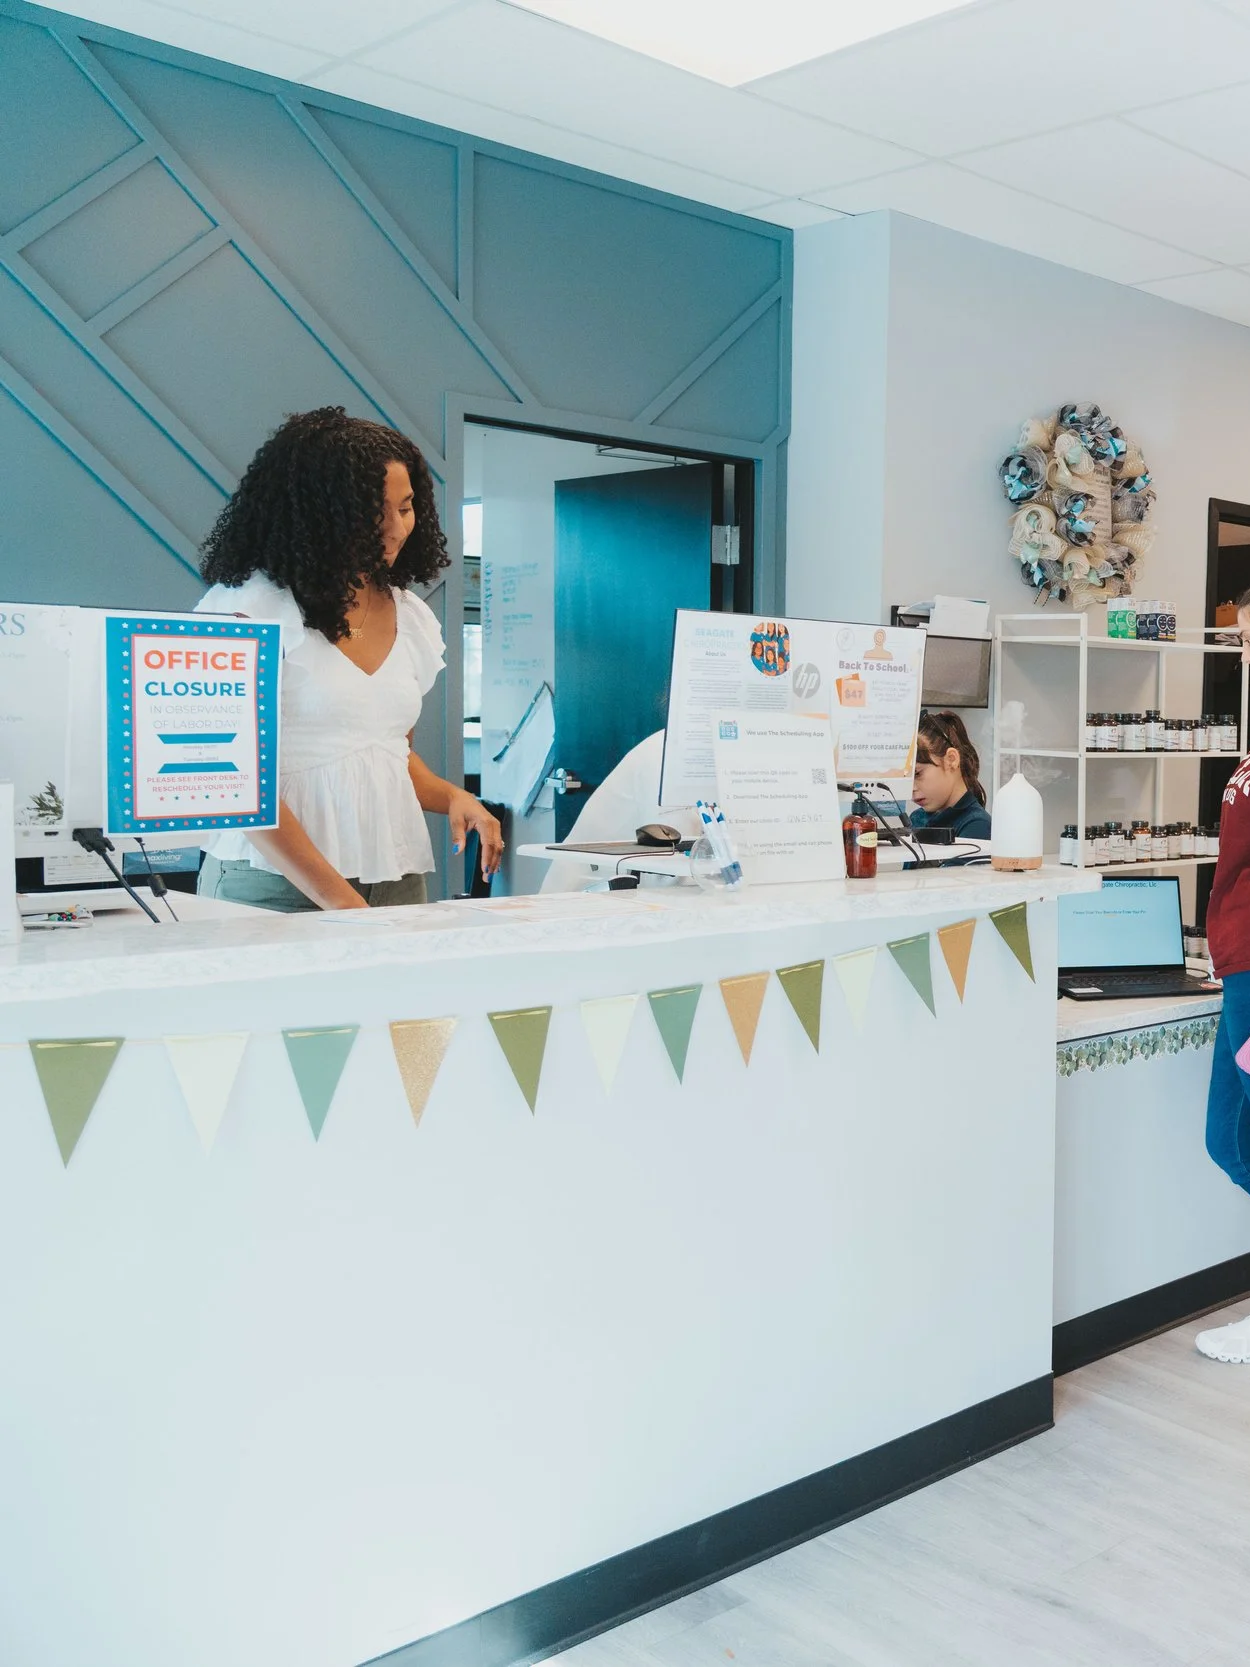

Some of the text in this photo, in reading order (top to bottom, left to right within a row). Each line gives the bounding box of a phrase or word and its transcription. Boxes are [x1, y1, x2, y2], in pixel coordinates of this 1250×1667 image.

[144, 650, 246, 671] OFFICE
[839, 660, 861, 671] Back
[863, 661, 874, 671] To
[144, 681, 246, 697] CLOSURE
[844, 688, 864, 700] $47
[150, 704, 244, 715] IN OBSERVANCE
[153, 719, 169, 729] OF
[172, 719, 213, 730] LABOR
[780, 730, 812, 738] Scheduling
[146, 776, 175, 784] PLEASE
[152, 783, 203, 793] RESCHEDULE
[204, 783, 225, 791] YOUR
[1114, 881, 1148, 889] Chiropractic,
